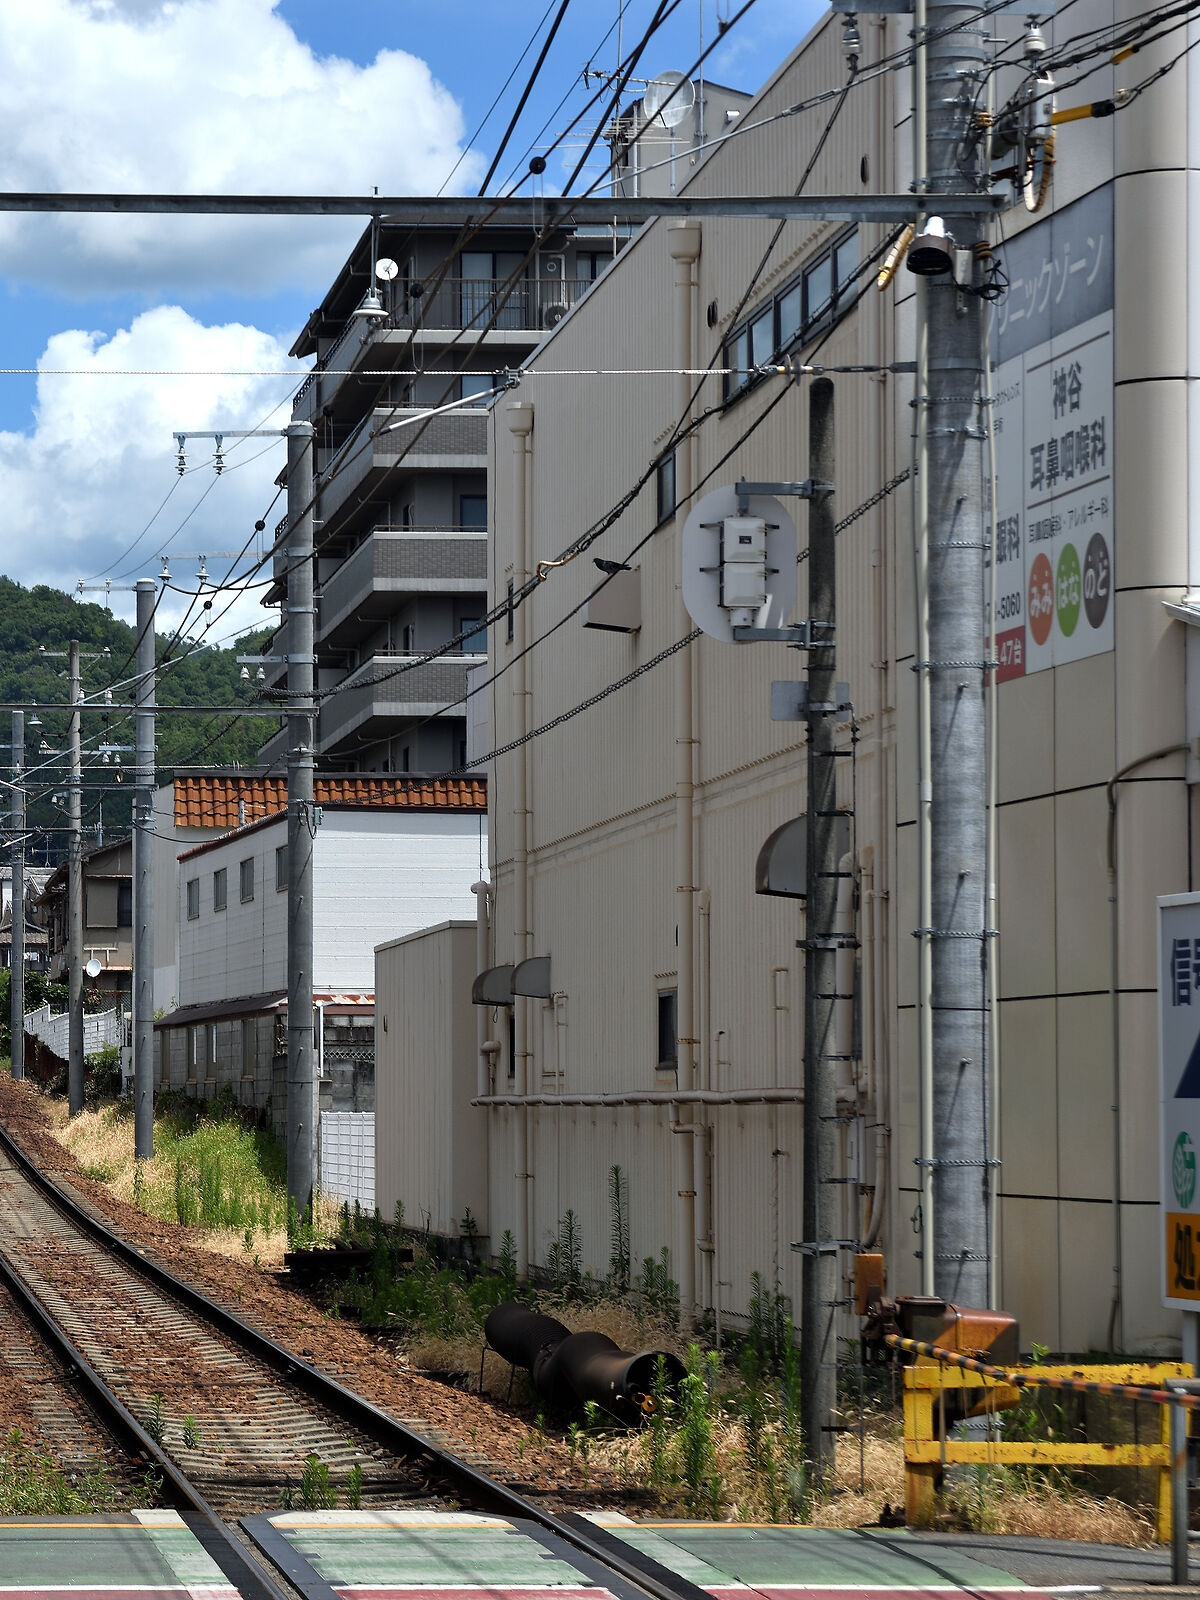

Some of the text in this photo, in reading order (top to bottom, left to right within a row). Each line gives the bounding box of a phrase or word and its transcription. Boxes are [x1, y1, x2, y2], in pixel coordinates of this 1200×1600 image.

[1053, 361, 1082, 420] 神谷
[1030, 416, 1106, 491] 耳鼻咽喉科
[1030, 559, 1109, 618] みみ はな のど
